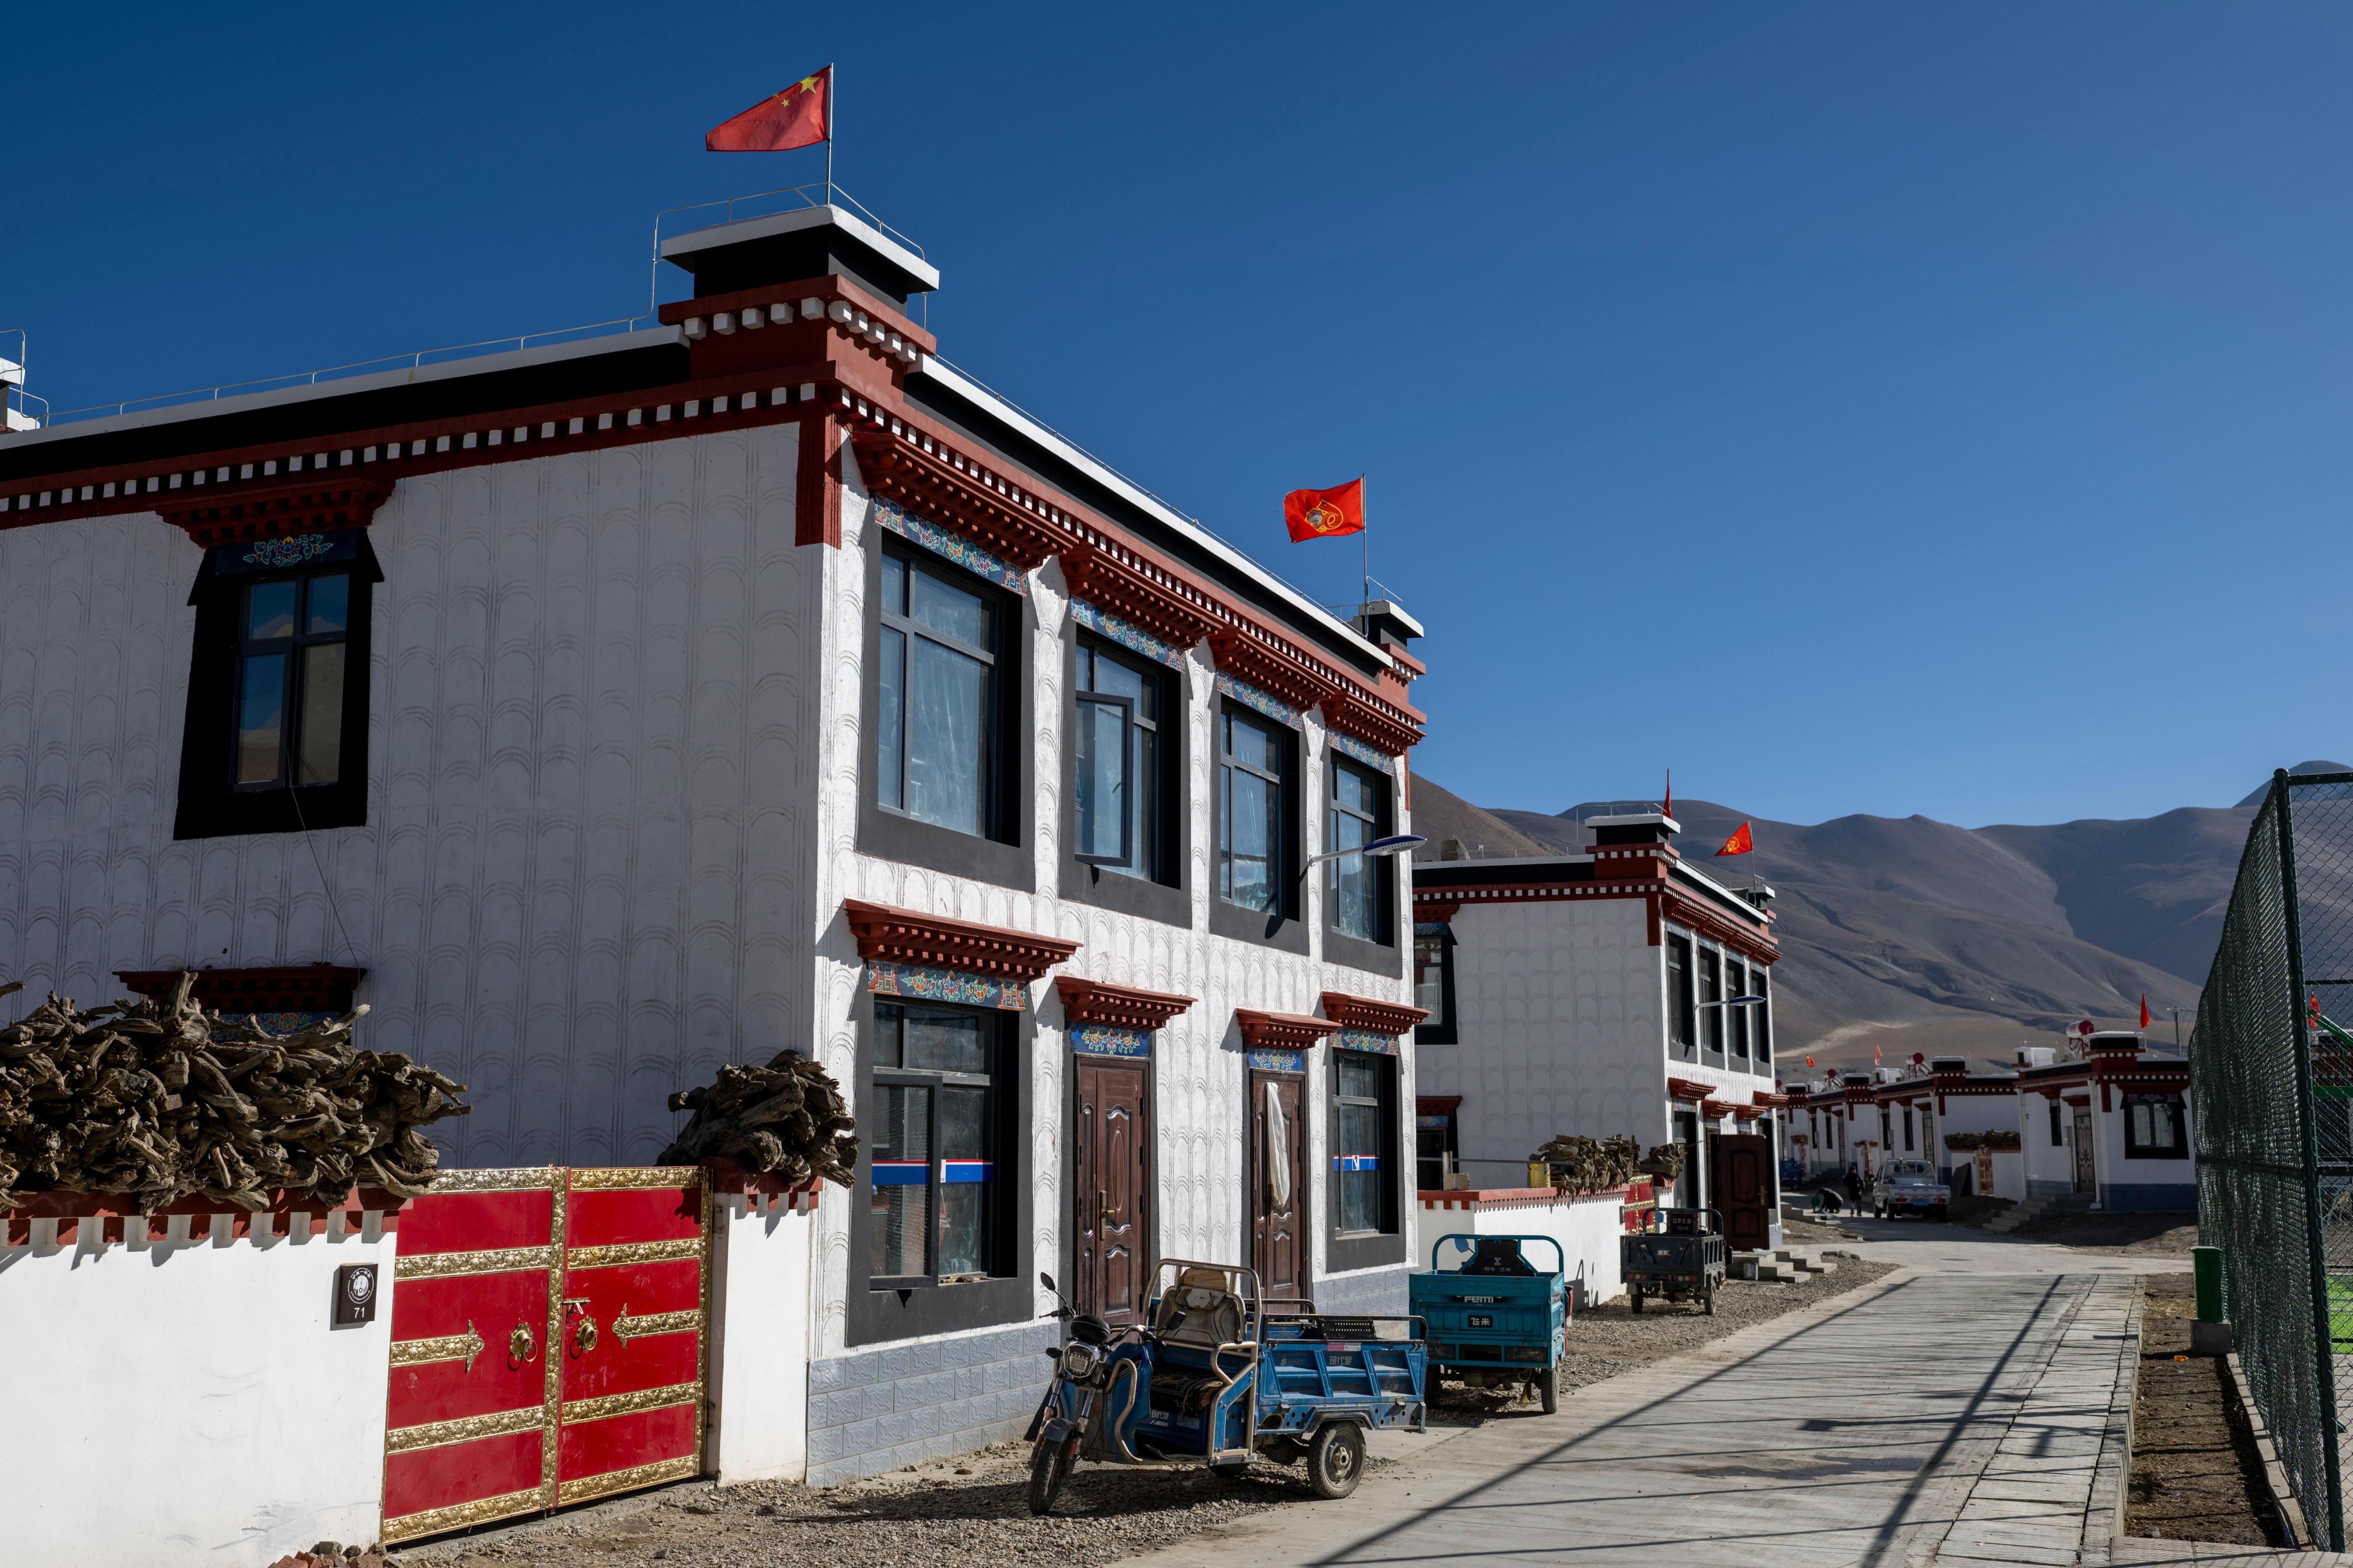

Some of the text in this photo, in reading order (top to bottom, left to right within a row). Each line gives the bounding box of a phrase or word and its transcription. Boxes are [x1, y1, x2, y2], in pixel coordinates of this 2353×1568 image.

[354, 1307, 364, 1318] 71
[1471, 1317, 1490, 1326] 飞米
[1329, 1356, 1352, 1365] 现代梦
[1151, 1410, 1169, 1420] 现代梦
